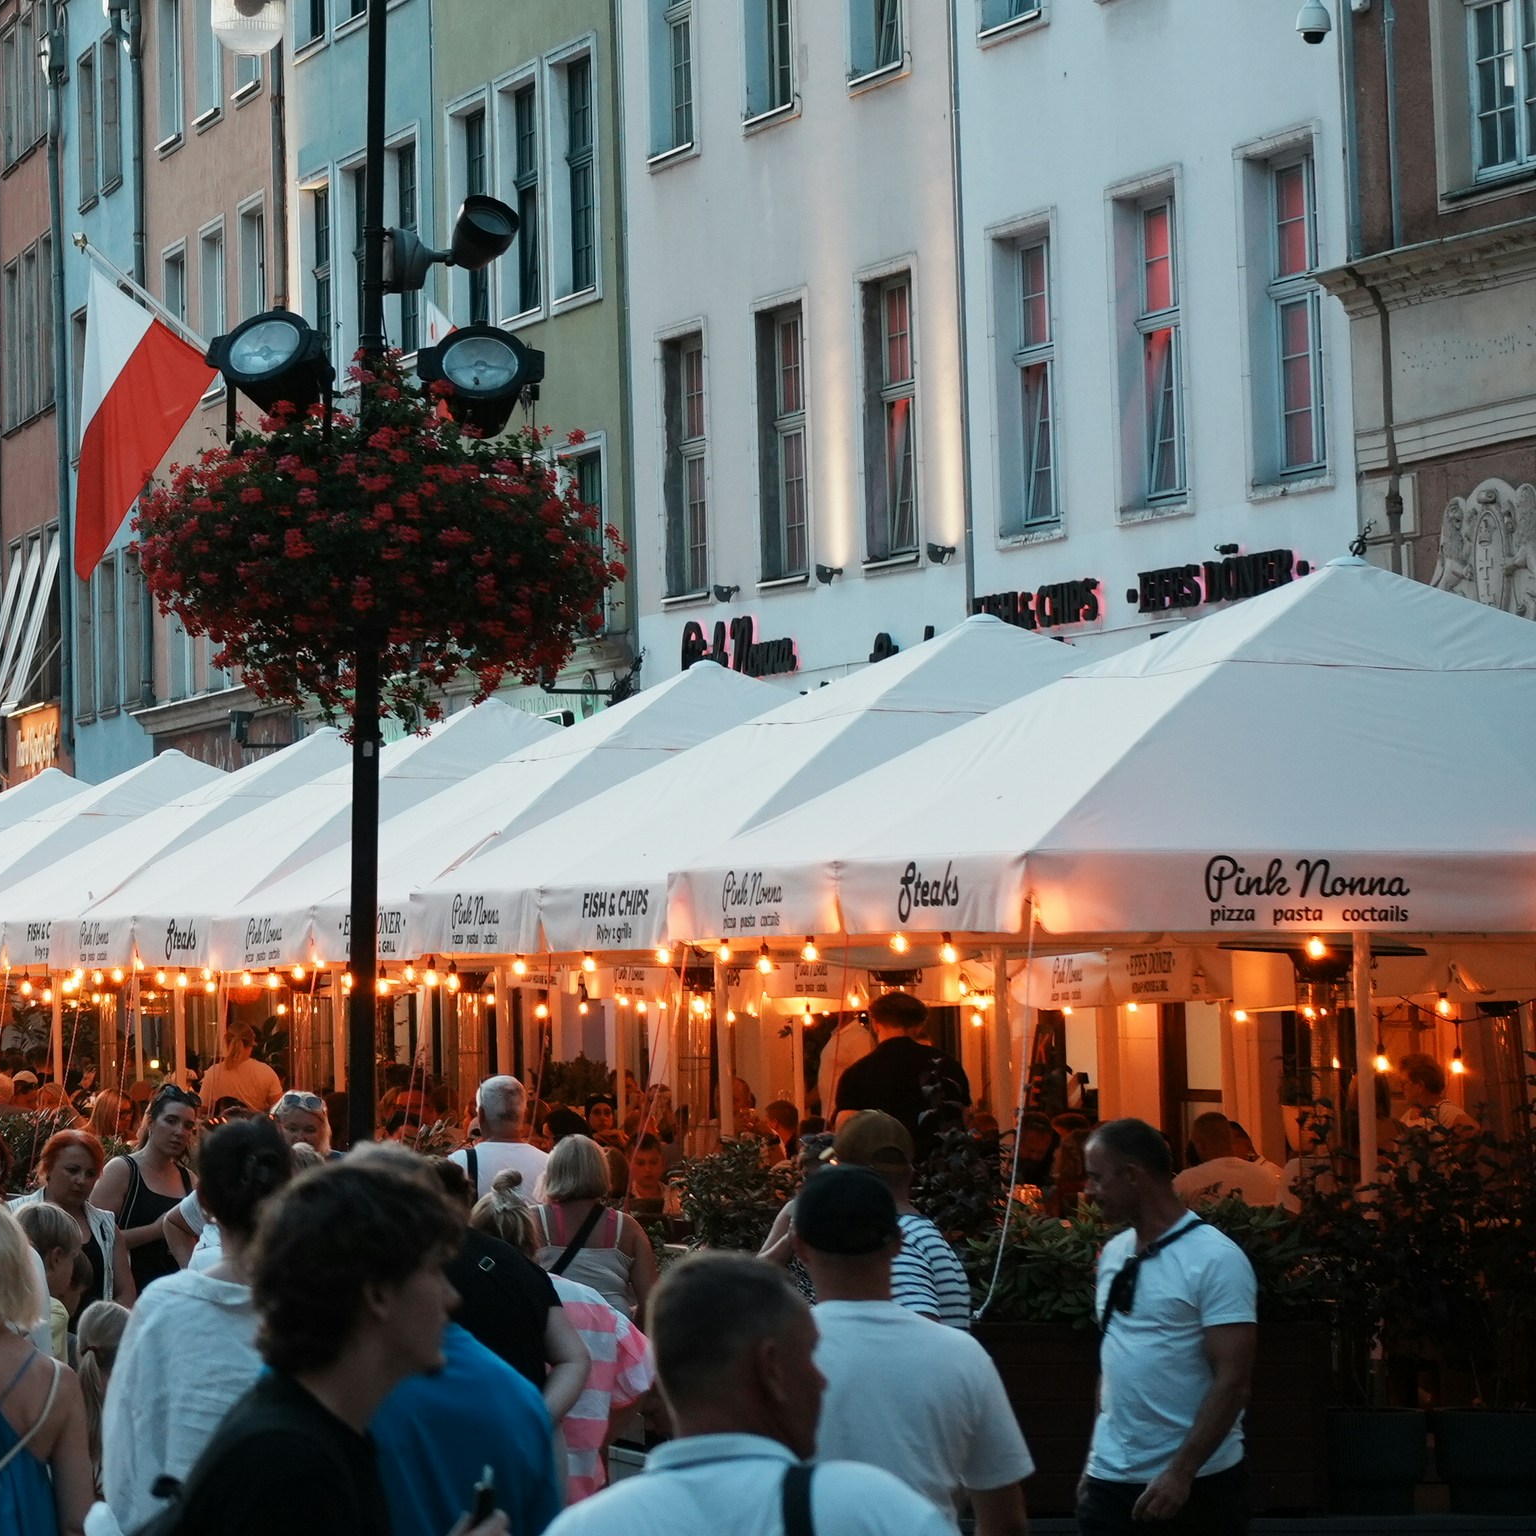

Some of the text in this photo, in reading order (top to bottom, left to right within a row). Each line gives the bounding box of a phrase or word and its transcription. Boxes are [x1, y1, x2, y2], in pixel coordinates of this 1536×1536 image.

[1037, 578, 1101, 628] CHIPS
[722, 870, 783, 912] Pink Nonna
[898, 860, 959, 923] Steaks
[1205, 855, 1410, 902] Pink Nonna
[582, 888, 649, 918] FISH & CHIPS
[1210, 905, 1408, 925] pizza pasta coctails
[27, 923, 40, 942] FISH
[378, 906, 401, 935] ÖNER
[596, 924, 611, 944] Ryby
[616, 922, 632, 944] grilla
[740, 915, 755, 930] pasta
[165, 918, 197, 960] Steaks
